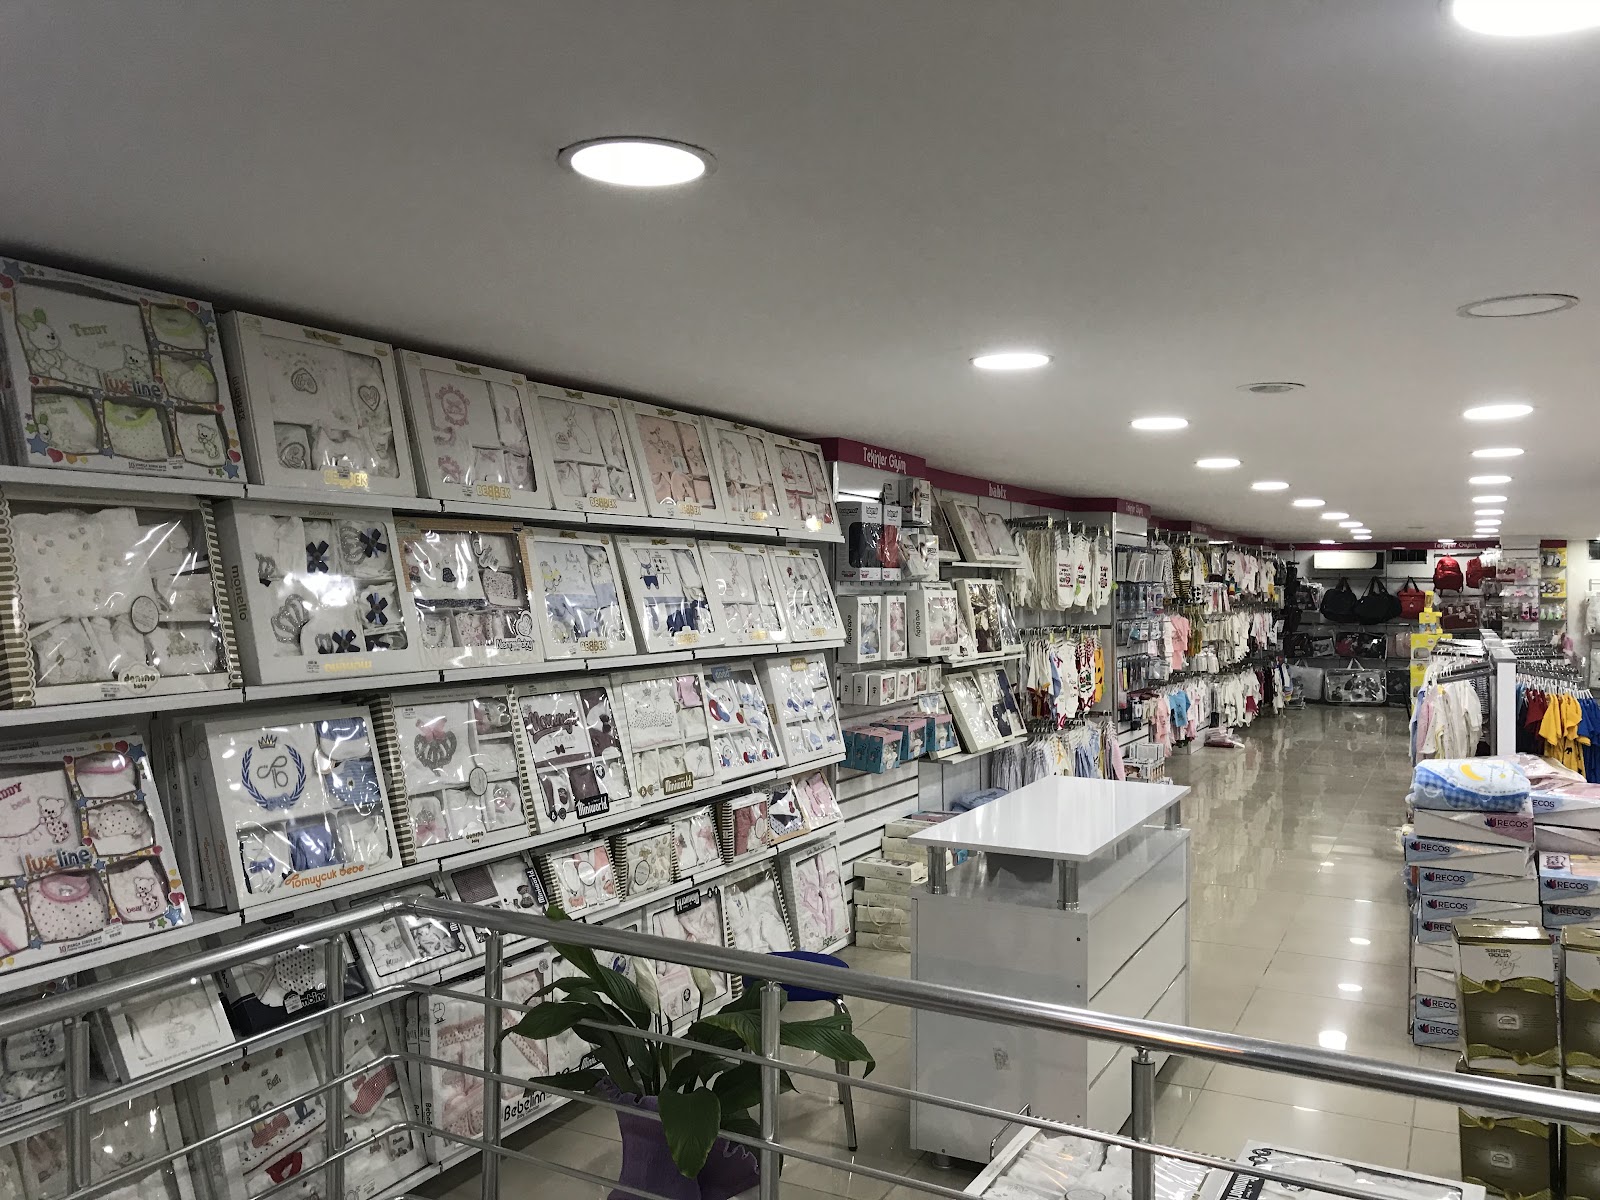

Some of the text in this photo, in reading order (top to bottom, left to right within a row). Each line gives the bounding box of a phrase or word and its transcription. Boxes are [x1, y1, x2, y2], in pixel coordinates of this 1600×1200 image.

[889, 453, 907, 475] Giyim
[231, 565, 247, 621] monello
[1497, 818, 1528, 829] RECOS
[1421, 842, 1450, 852] RECOS
[339, 863, 365, 876] bebe
[1435, 873, 1466, 883] RECOS
[527, 870, 546, 904] Miniworld
[1557, 881, 1589, 891] RECOS
[1438, 901, 1468, 911] RECOS
[1559, 906, 1592, 917] RECOS
[1433, 922, 1451, 933] REC
[301, 991, 327, 1008] mbino
[1432, 999, 1457, 1010] RECO
[1430, 1026, 1460, 1037] RECOS
